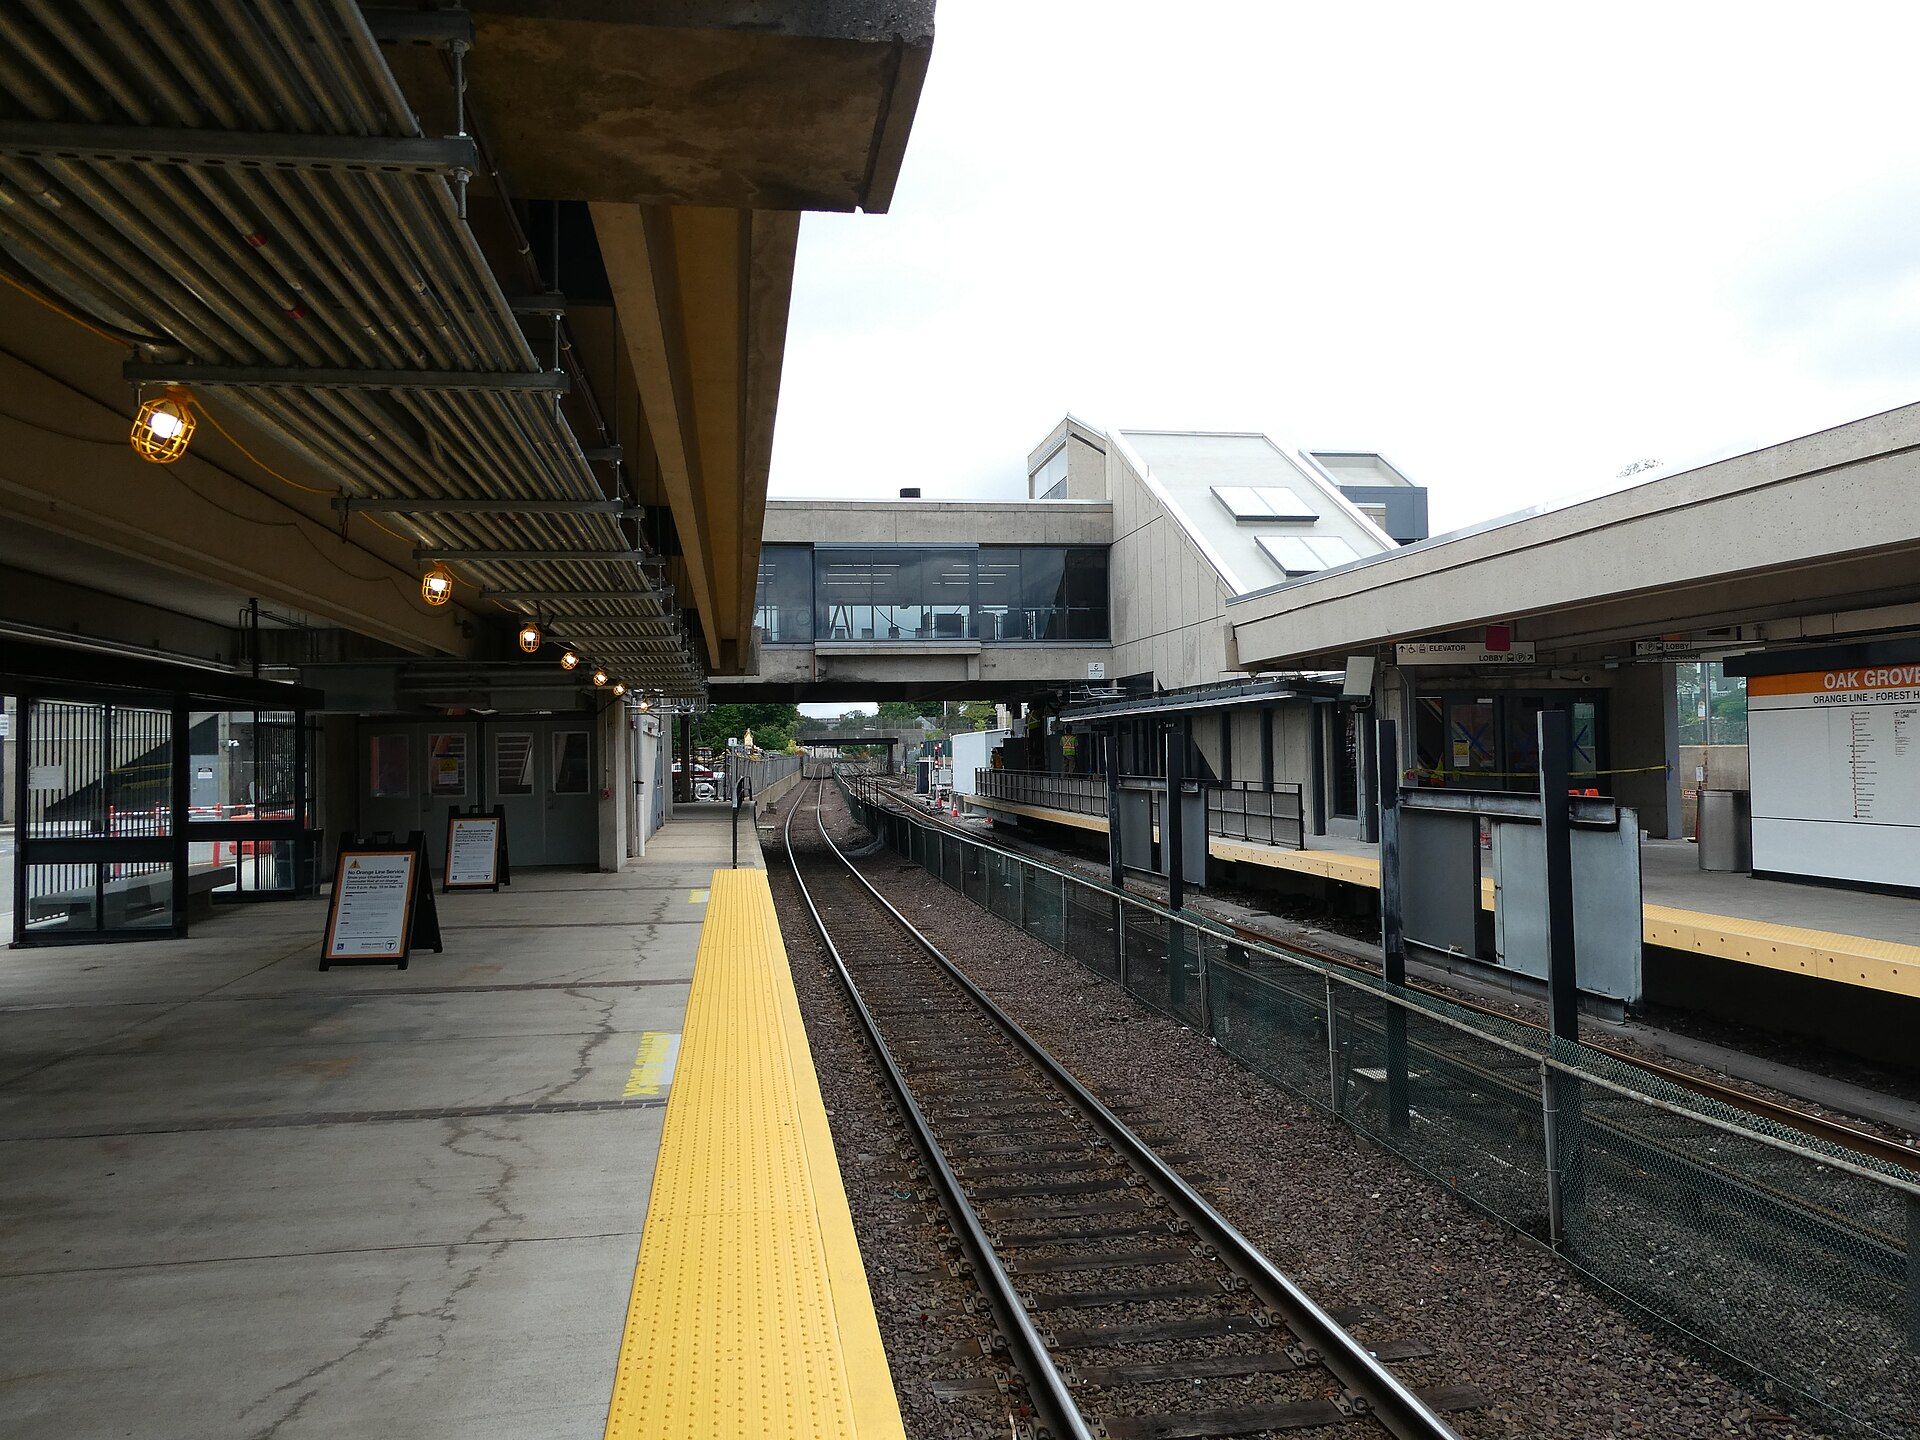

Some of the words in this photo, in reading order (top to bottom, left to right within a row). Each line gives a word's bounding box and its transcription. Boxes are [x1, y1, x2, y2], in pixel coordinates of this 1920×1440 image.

[1479, 654, 1504, 662] LOBBY
[1824, 671, 1859, 689] OAK
[1813, 694, 1847, 704] ORANGE
[1849, 693, 1868, 702] LINE
[1876, 691, 1910, 701] FOREST
